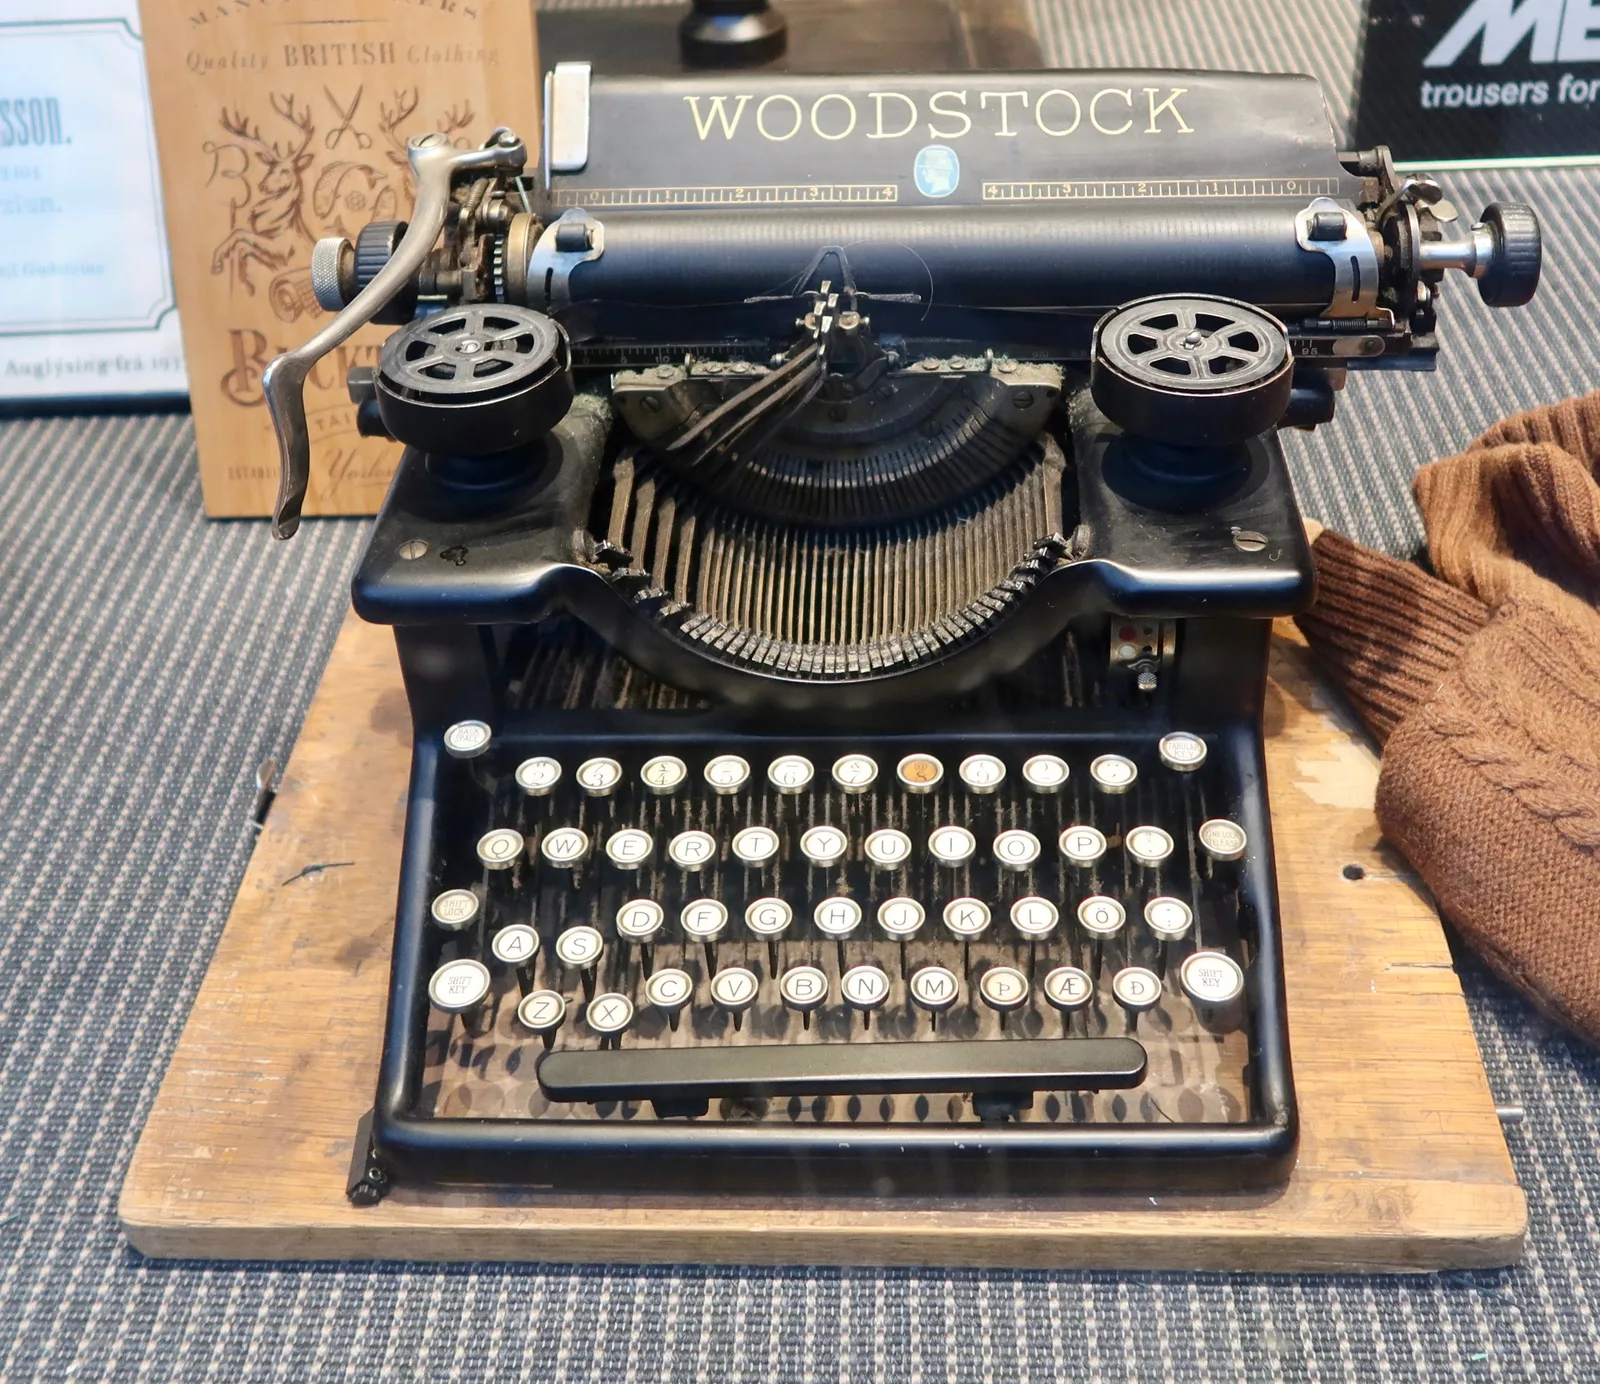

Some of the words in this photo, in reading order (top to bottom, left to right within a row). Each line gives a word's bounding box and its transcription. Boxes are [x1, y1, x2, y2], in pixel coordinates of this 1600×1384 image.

[284, 42, 396, 67] BRITISH
[1420, 80, 1549, 109] trousers
[1558, 73, 1600, 104] for
[683, 87, 1195, 141] WOODSTOCK
[735, 187, 745, 198] 2
[809, 187, 819, 197] 3
[882, 187, 893, 197] 4
[988, 185, 998, 195] 4
[1063, 184, 1073, 193] 3
[1138, 183, 1148, 193] 2
[1213, 183, 1219, 193] 1
[1287, 181, 1297, 191] 0
[530, 772, 544, 785] 2
[590, 774, 603, 786] 3
[655, 772, 667, 785] 4
[784, 771, 796, 785] 6
[491, 839, 509, 858] Q
[555, 839, 577, 854] W
[622, 840, 637, 855] E
[684, 841, 702, 857] R
[750, 837, 764, 852] T
[817, 837, 832, 852] Y
[881, 840, 896, 855] U
[1007, 840, 1025, 856] O
[1077, 836, 1093, 852] P
[444, 900, 468, 908] SHIFT
[444, 907, 464, 916] LOCK
[506, 936, 522, 952] A
[571, 938, 587, 955] S
[631, 911, 650, 927] D
[696, 911, 712, 928] F
[759, 909, 777, 926] G
[829, 909, 846, 925] H
[893, 909, 907, 926] J
[959, 910, 976, 926] K
[1028, 909, 1043, 925] L
[1095, 907, 1109, 924] Ö
[1198, 968, 1223, 978] SHIFT
[447, 977, 473, 985] SHIFT
[1202, 977, 1221, 988] KEY
[448, 985, 468, 994] KEY
[532, 1001, 550, 1019] Z
[600, 1004, 618, 1022] X
[660, 980, 677, 998] C
[727, 980, 743, 997] V
[795, 979, 813, 996] B
[858, 978, 874, 995] N
[925, 979, 944, 996] M
[1058, 977, 1080, 996] Æ
